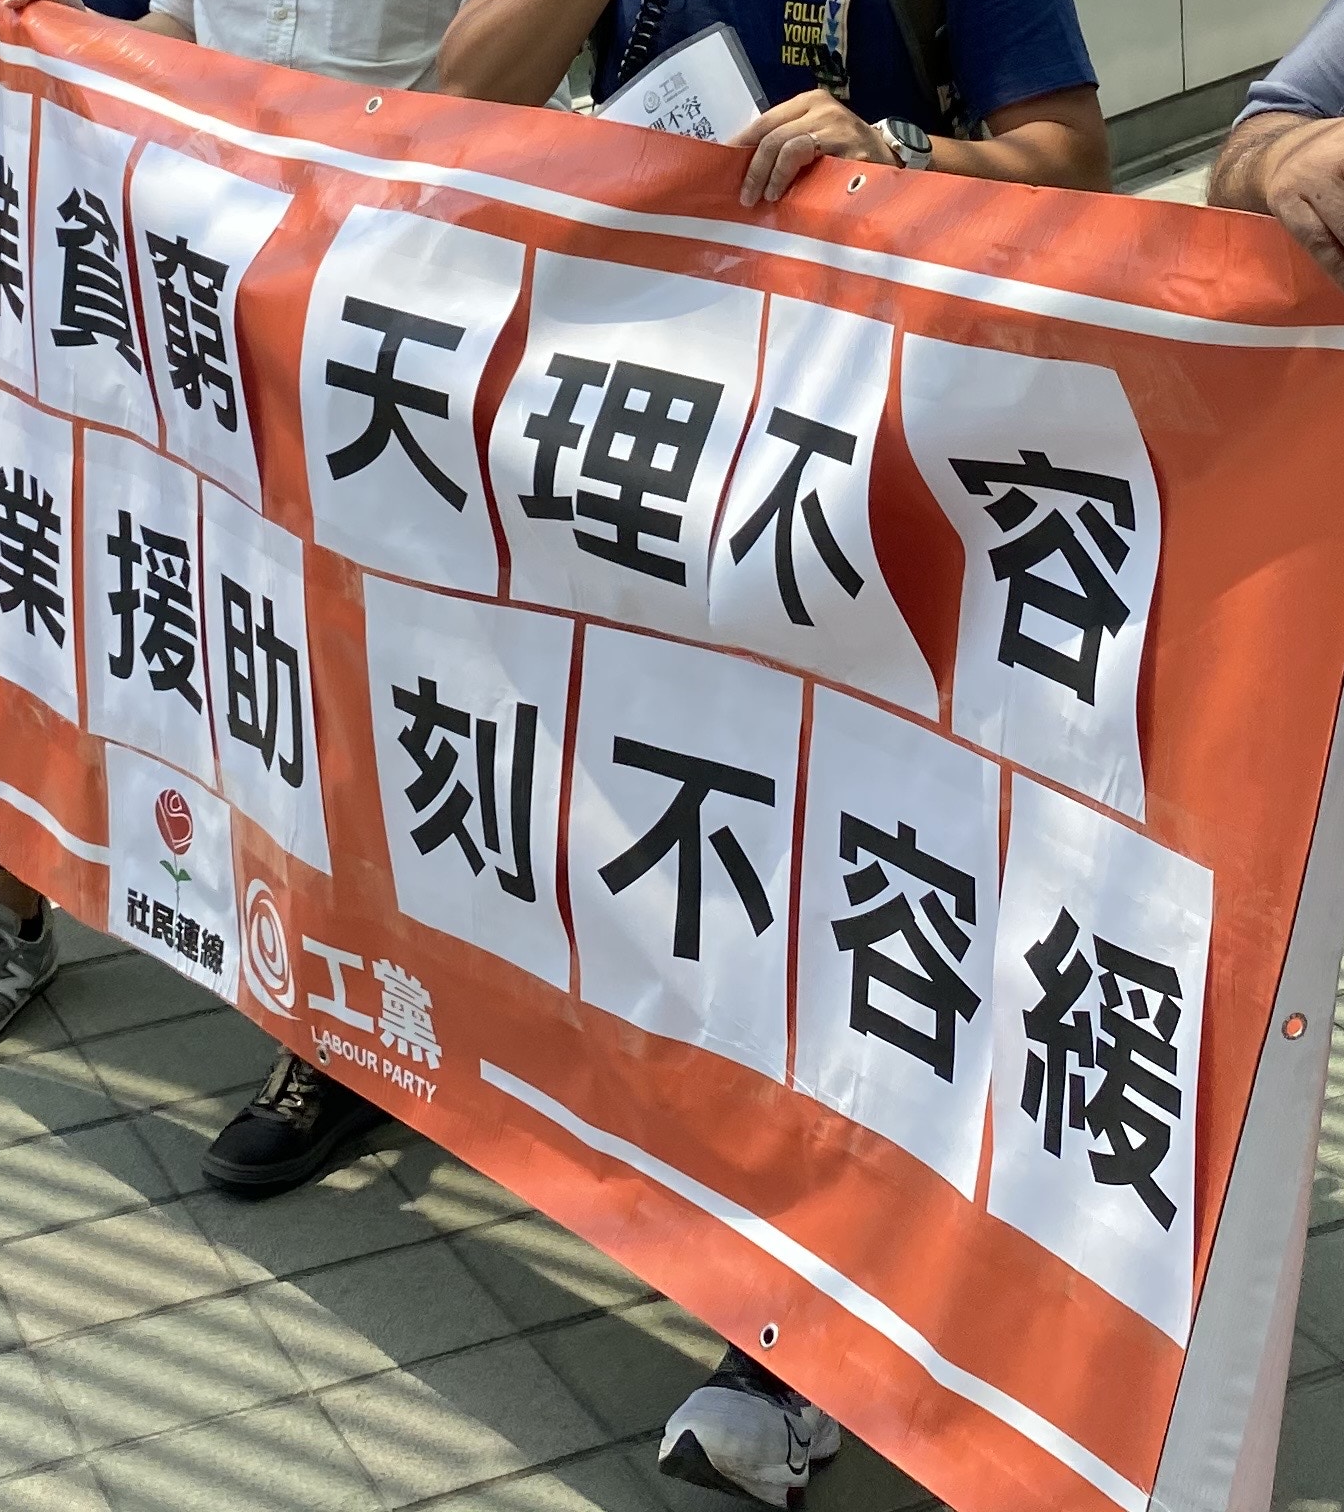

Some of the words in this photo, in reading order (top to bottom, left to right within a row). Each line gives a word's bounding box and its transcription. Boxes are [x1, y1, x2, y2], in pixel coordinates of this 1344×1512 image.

[782, 45, 820, 67] HEA
[784, 1, 826, 23] FOLLO
[325, 295, 1136, 707] 天理不容
[127, 887, 225, 976] 社民連線
[392, 676, 1183, 1232] 刻不容緩
[302, 934, 442, 1070] 工黨
[311, 1026, 378, 1073] LABOUR
[382, 1058, 437, 1103] PARTY
